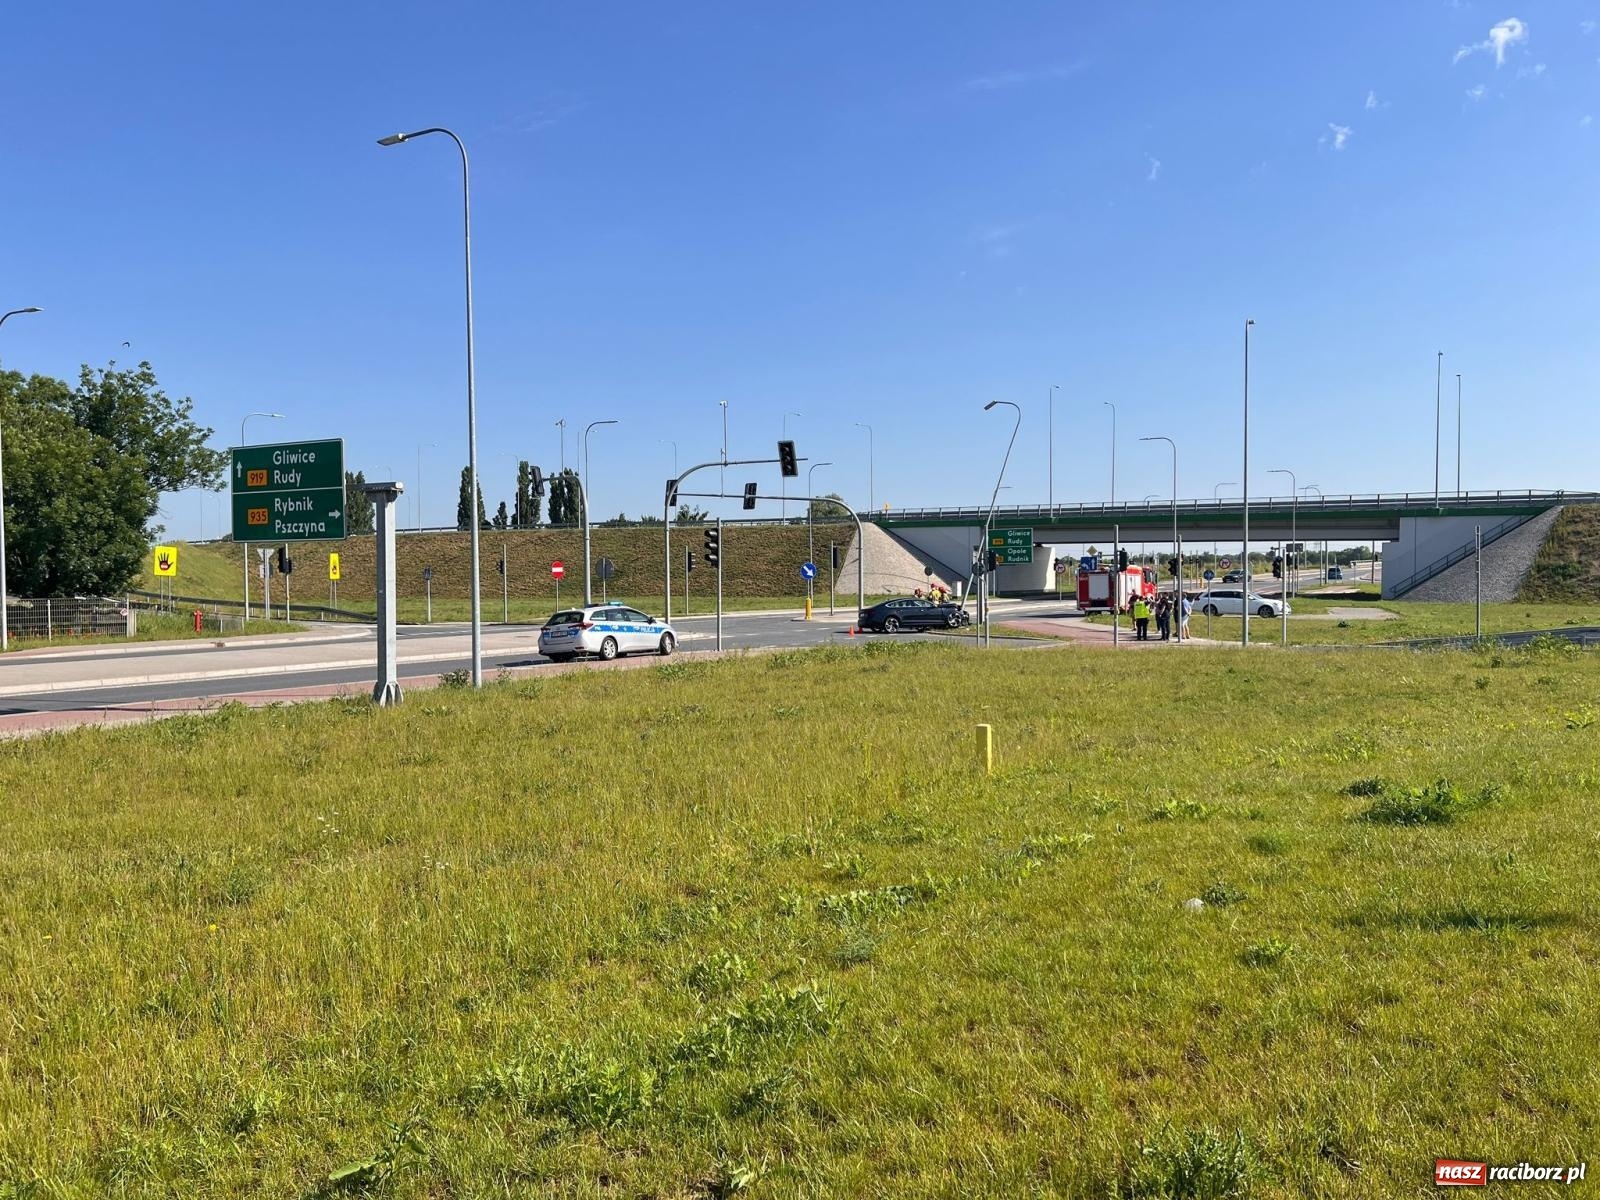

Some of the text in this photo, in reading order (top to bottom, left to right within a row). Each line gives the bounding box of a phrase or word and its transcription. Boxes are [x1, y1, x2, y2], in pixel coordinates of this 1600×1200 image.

[272, 449, 316, 465] Gliwice
[250, 472, 264, 484] 919
[273, 468, 302, 487] Rudy
[274, 496, 313, 516] Rybnik
[250, 511, 267, 522] 935
[275, 519, 326, 537] Pszczyna
